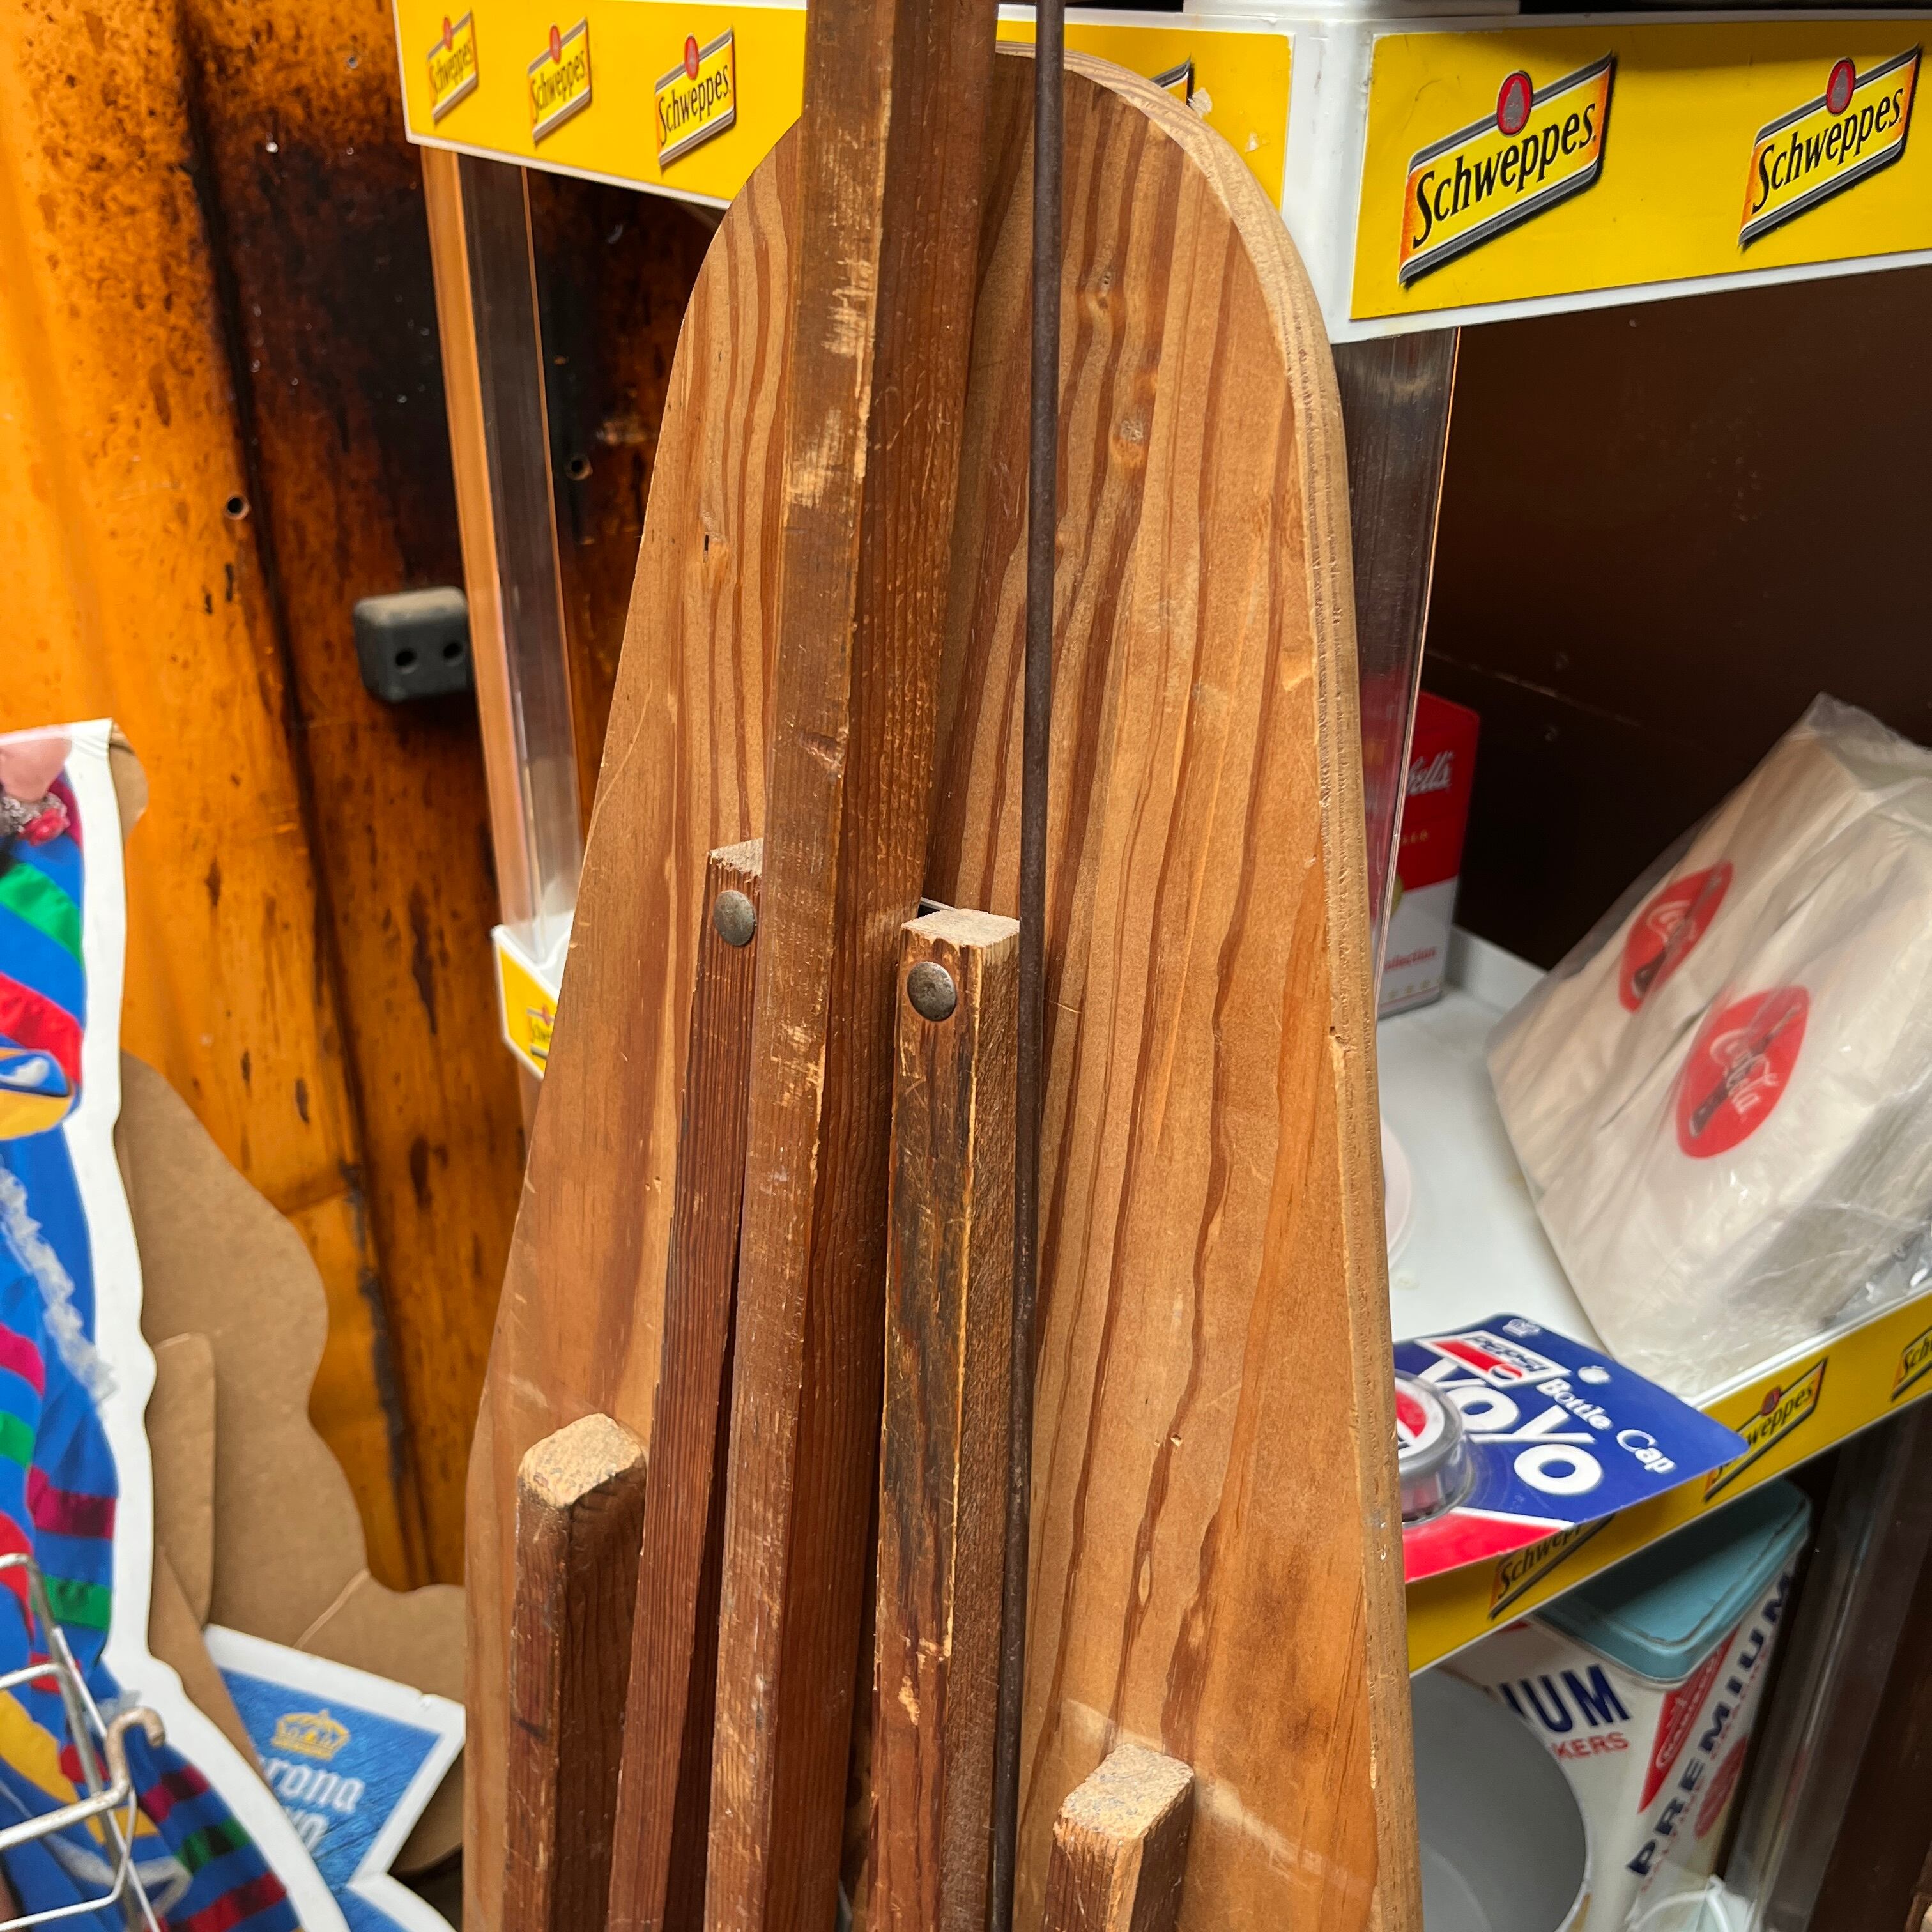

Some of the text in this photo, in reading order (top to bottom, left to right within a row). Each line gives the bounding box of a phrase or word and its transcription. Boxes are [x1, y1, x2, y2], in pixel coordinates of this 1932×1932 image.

[530, 50, 585, 125] Schweppes
[658, 65, 729, 146] Schweppes
[1412, 102, 1597, 249] Schweppes
[1751, 88, 1903, 215] Schweppes
[1536, 1378, 1676, 1473] Bottle Cap
[1551, 1732, 1629, 1758] KERS
[1626, 1572, 1790, 1876] PREMIUM
[259, 1758, 365, 1814] rona
